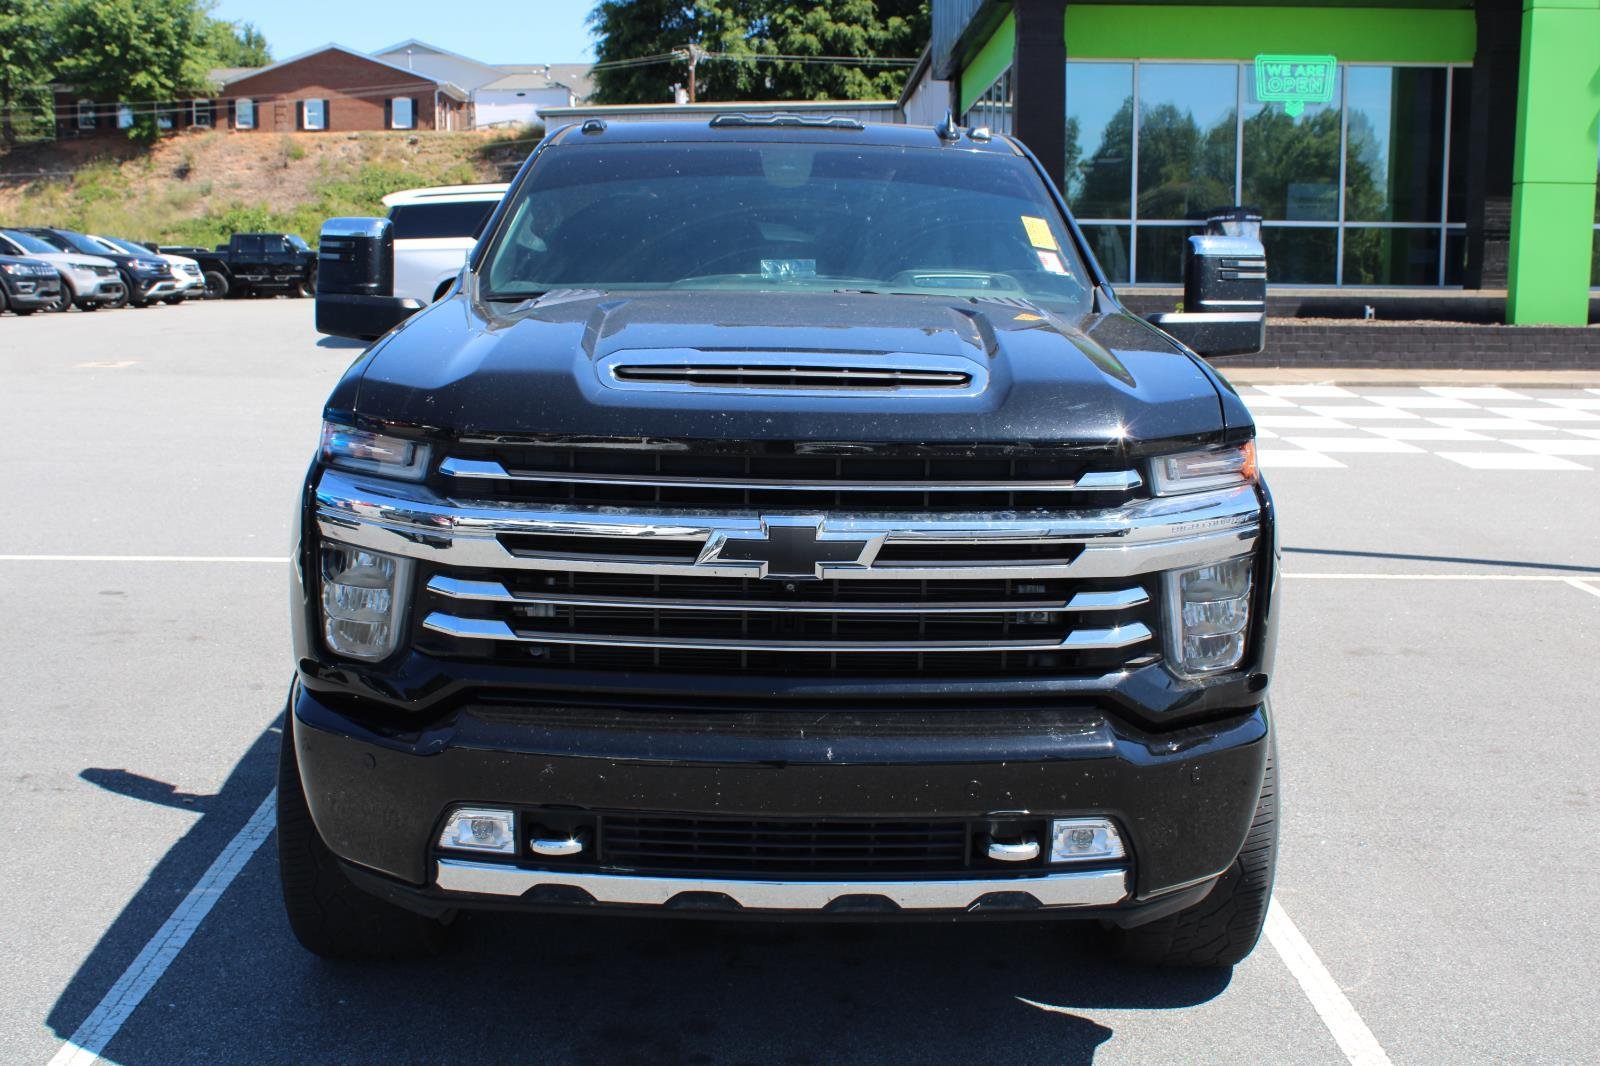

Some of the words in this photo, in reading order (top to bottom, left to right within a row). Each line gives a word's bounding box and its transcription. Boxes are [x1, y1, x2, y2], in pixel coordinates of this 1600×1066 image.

[1266, 64, 1291, 76] WE
[1295, 64, 1325, 76] ARE
[1268, 77, 1323, 93] OPEN
